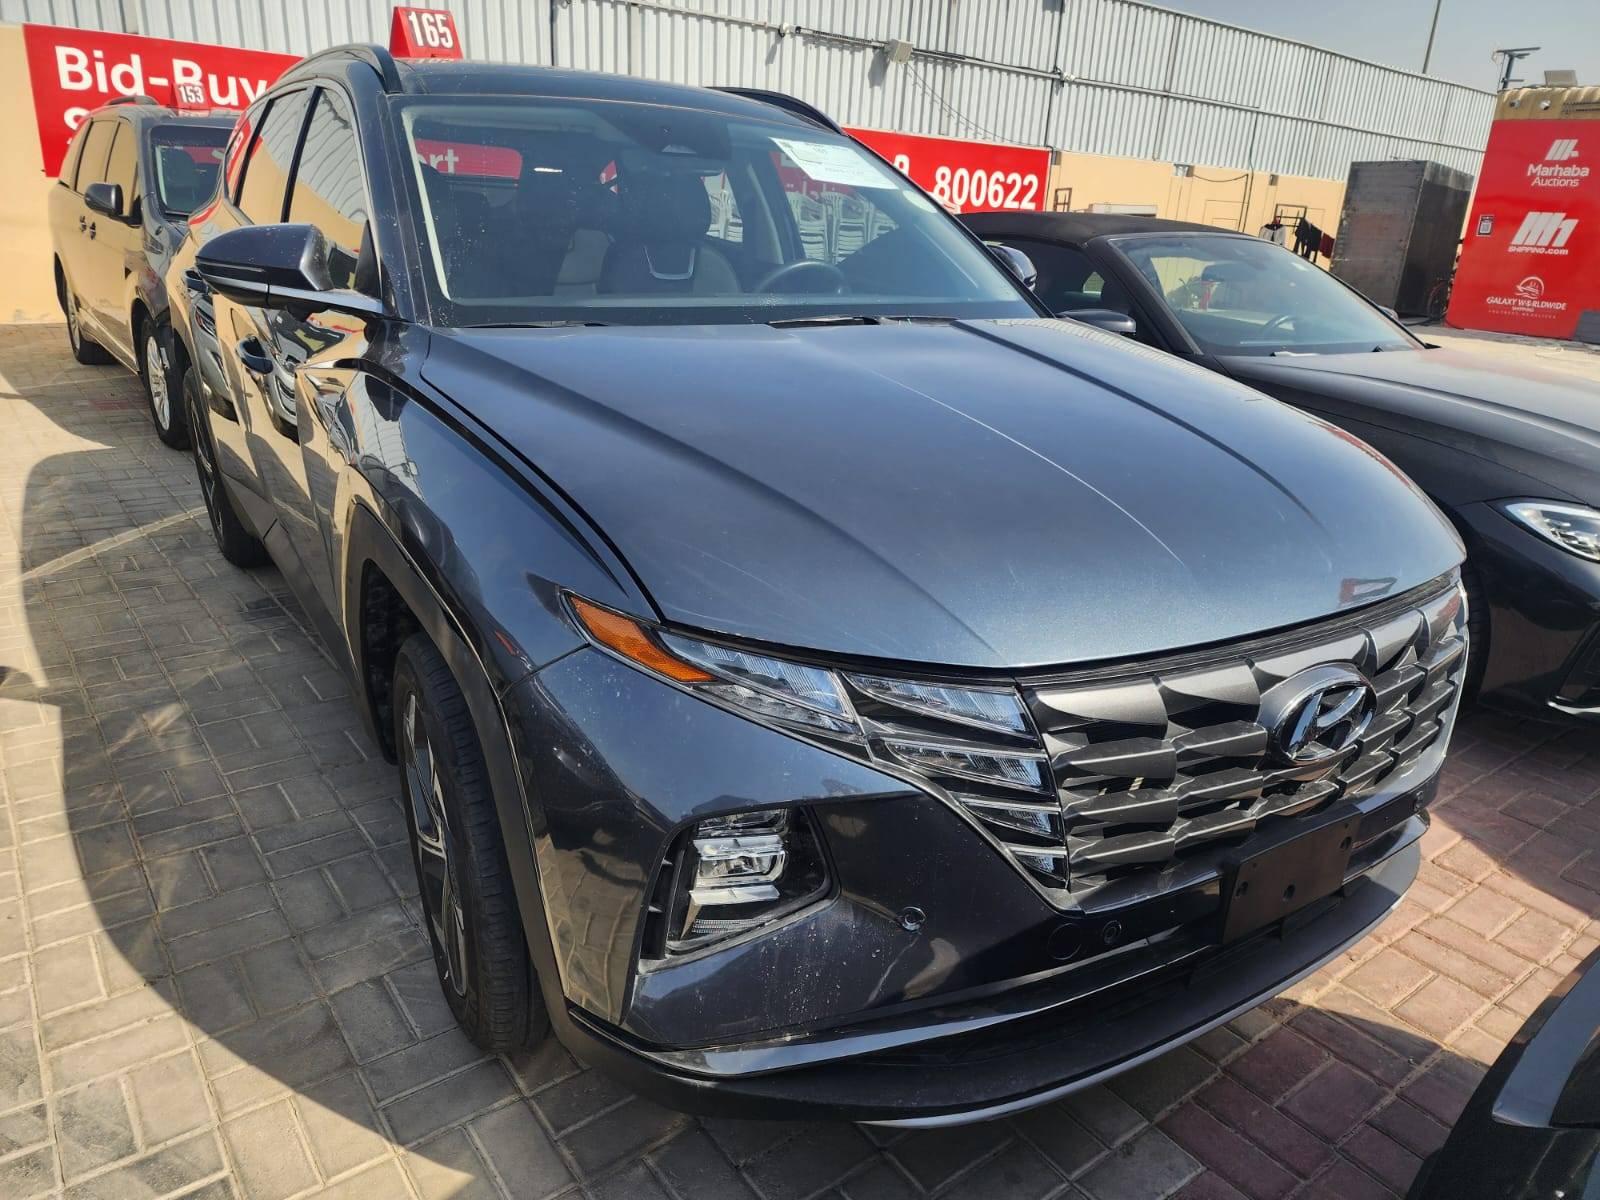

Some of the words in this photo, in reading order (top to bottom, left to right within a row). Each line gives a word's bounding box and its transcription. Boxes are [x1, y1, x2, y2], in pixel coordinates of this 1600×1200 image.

[408, 11, 454, 49] 165
[178, 85, 205, 104] 153
[1527, 164, 1590, 177] Marhaba
[932, 165, 1039, 210] 800622
[1531, 177, 1579, 187] Auctions
[1486, 296, 1517, 306] GALAXY
